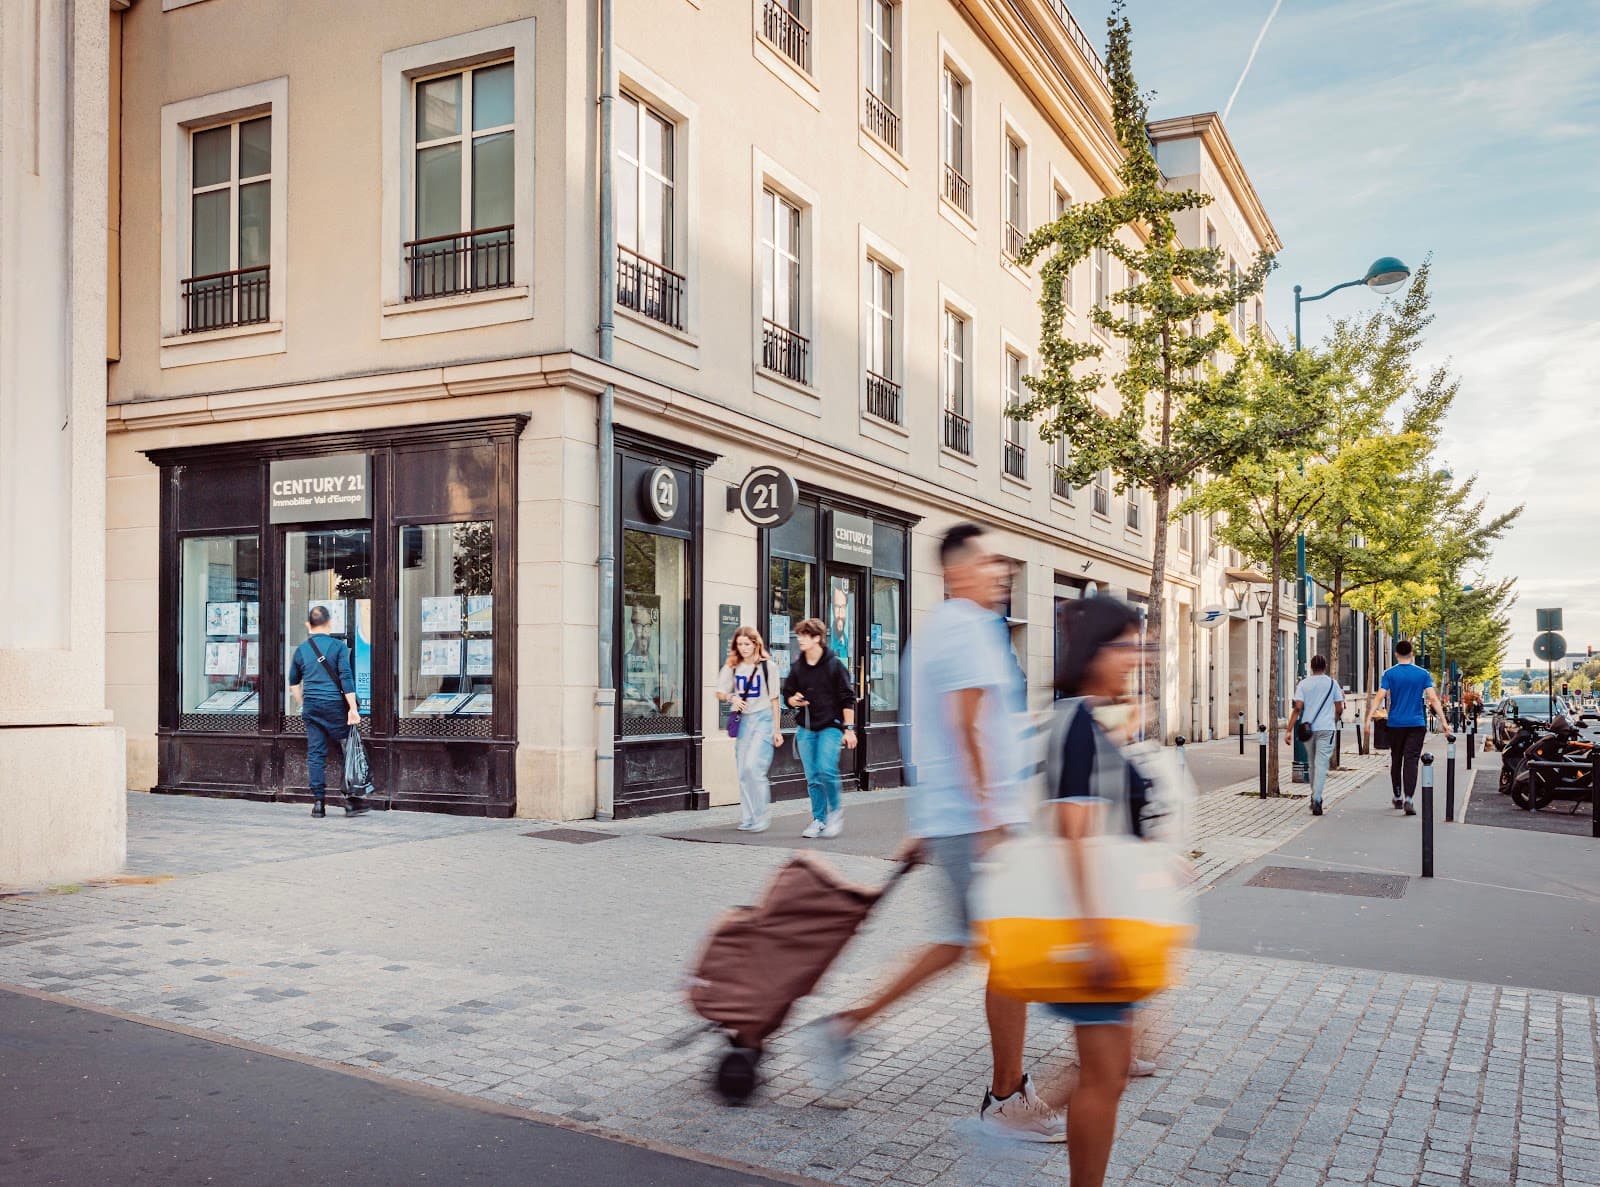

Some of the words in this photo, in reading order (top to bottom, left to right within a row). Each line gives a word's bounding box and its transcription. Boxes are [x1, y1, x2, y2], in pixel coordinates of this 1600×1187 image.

[272, 476, 345, 496] CENTURY
[347, 474, 365, 491] 21
[272, 496, 313, 507] Immobilier
[313, 495, 326, 505] Val
[327, 494, 362, 504] d'Europe
